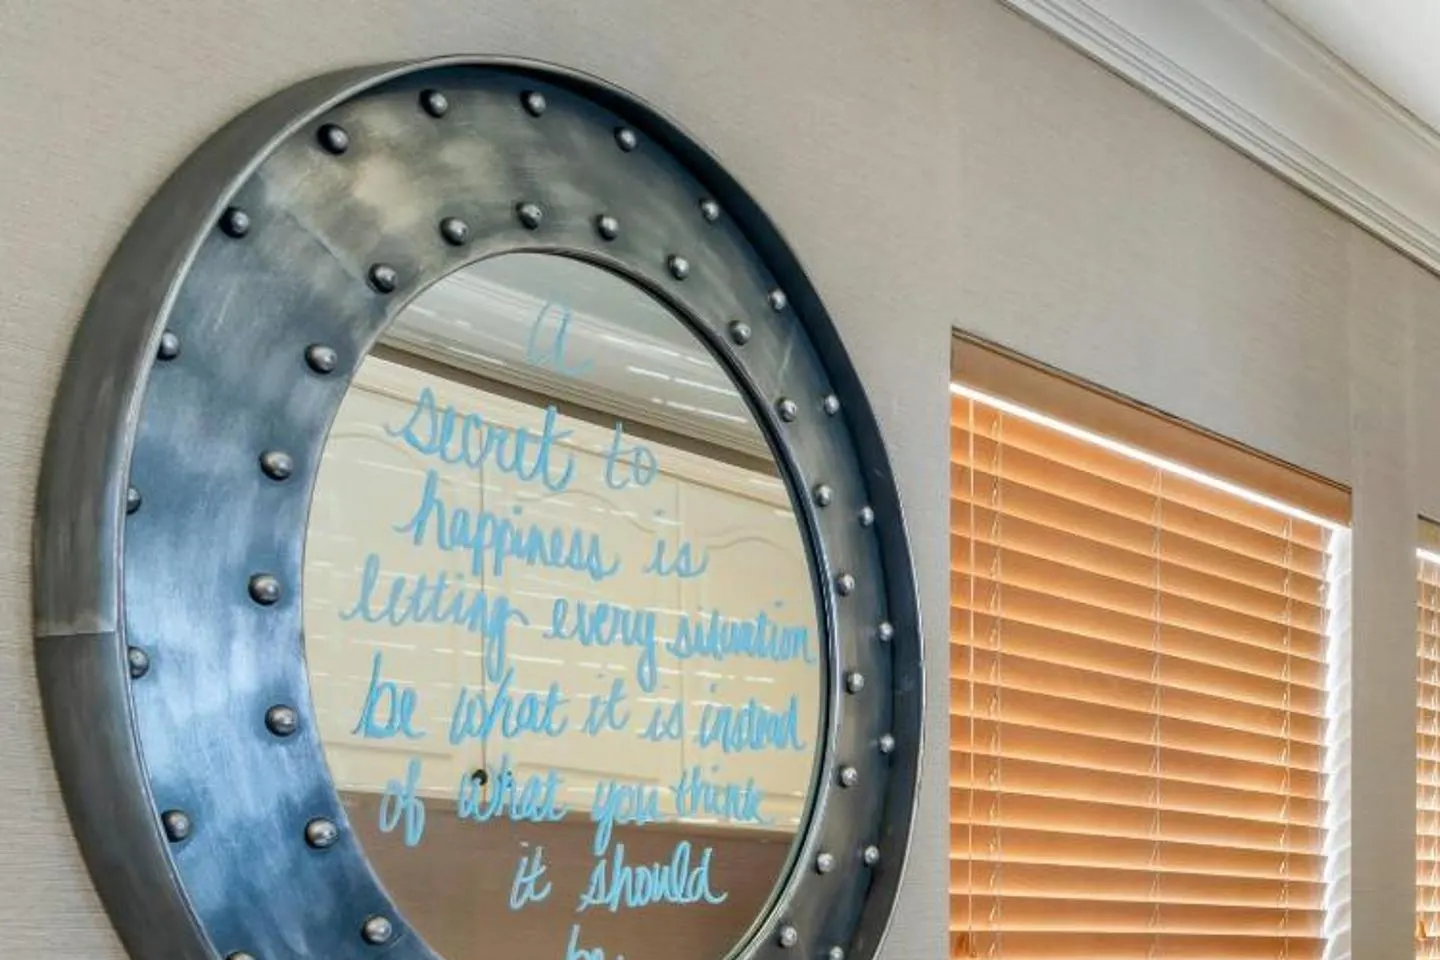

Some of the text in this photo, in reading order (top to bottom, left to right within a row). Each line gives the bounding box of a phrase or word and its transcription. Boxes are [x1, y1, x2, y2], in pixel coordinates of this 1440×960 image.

[386, 387, 658, 492] secret to
[393, 470, 709, 581] happiness is
[338, 552, 818, 693] letting every situation
[352, 650, 426, 738] be
[449, 664, 568, 744] what
[581, 671, 631, 737] it
[638, 683, 687, 742] is
[378, 752, 772, 854] of what you think
[507, 840, 728, 913] it should
